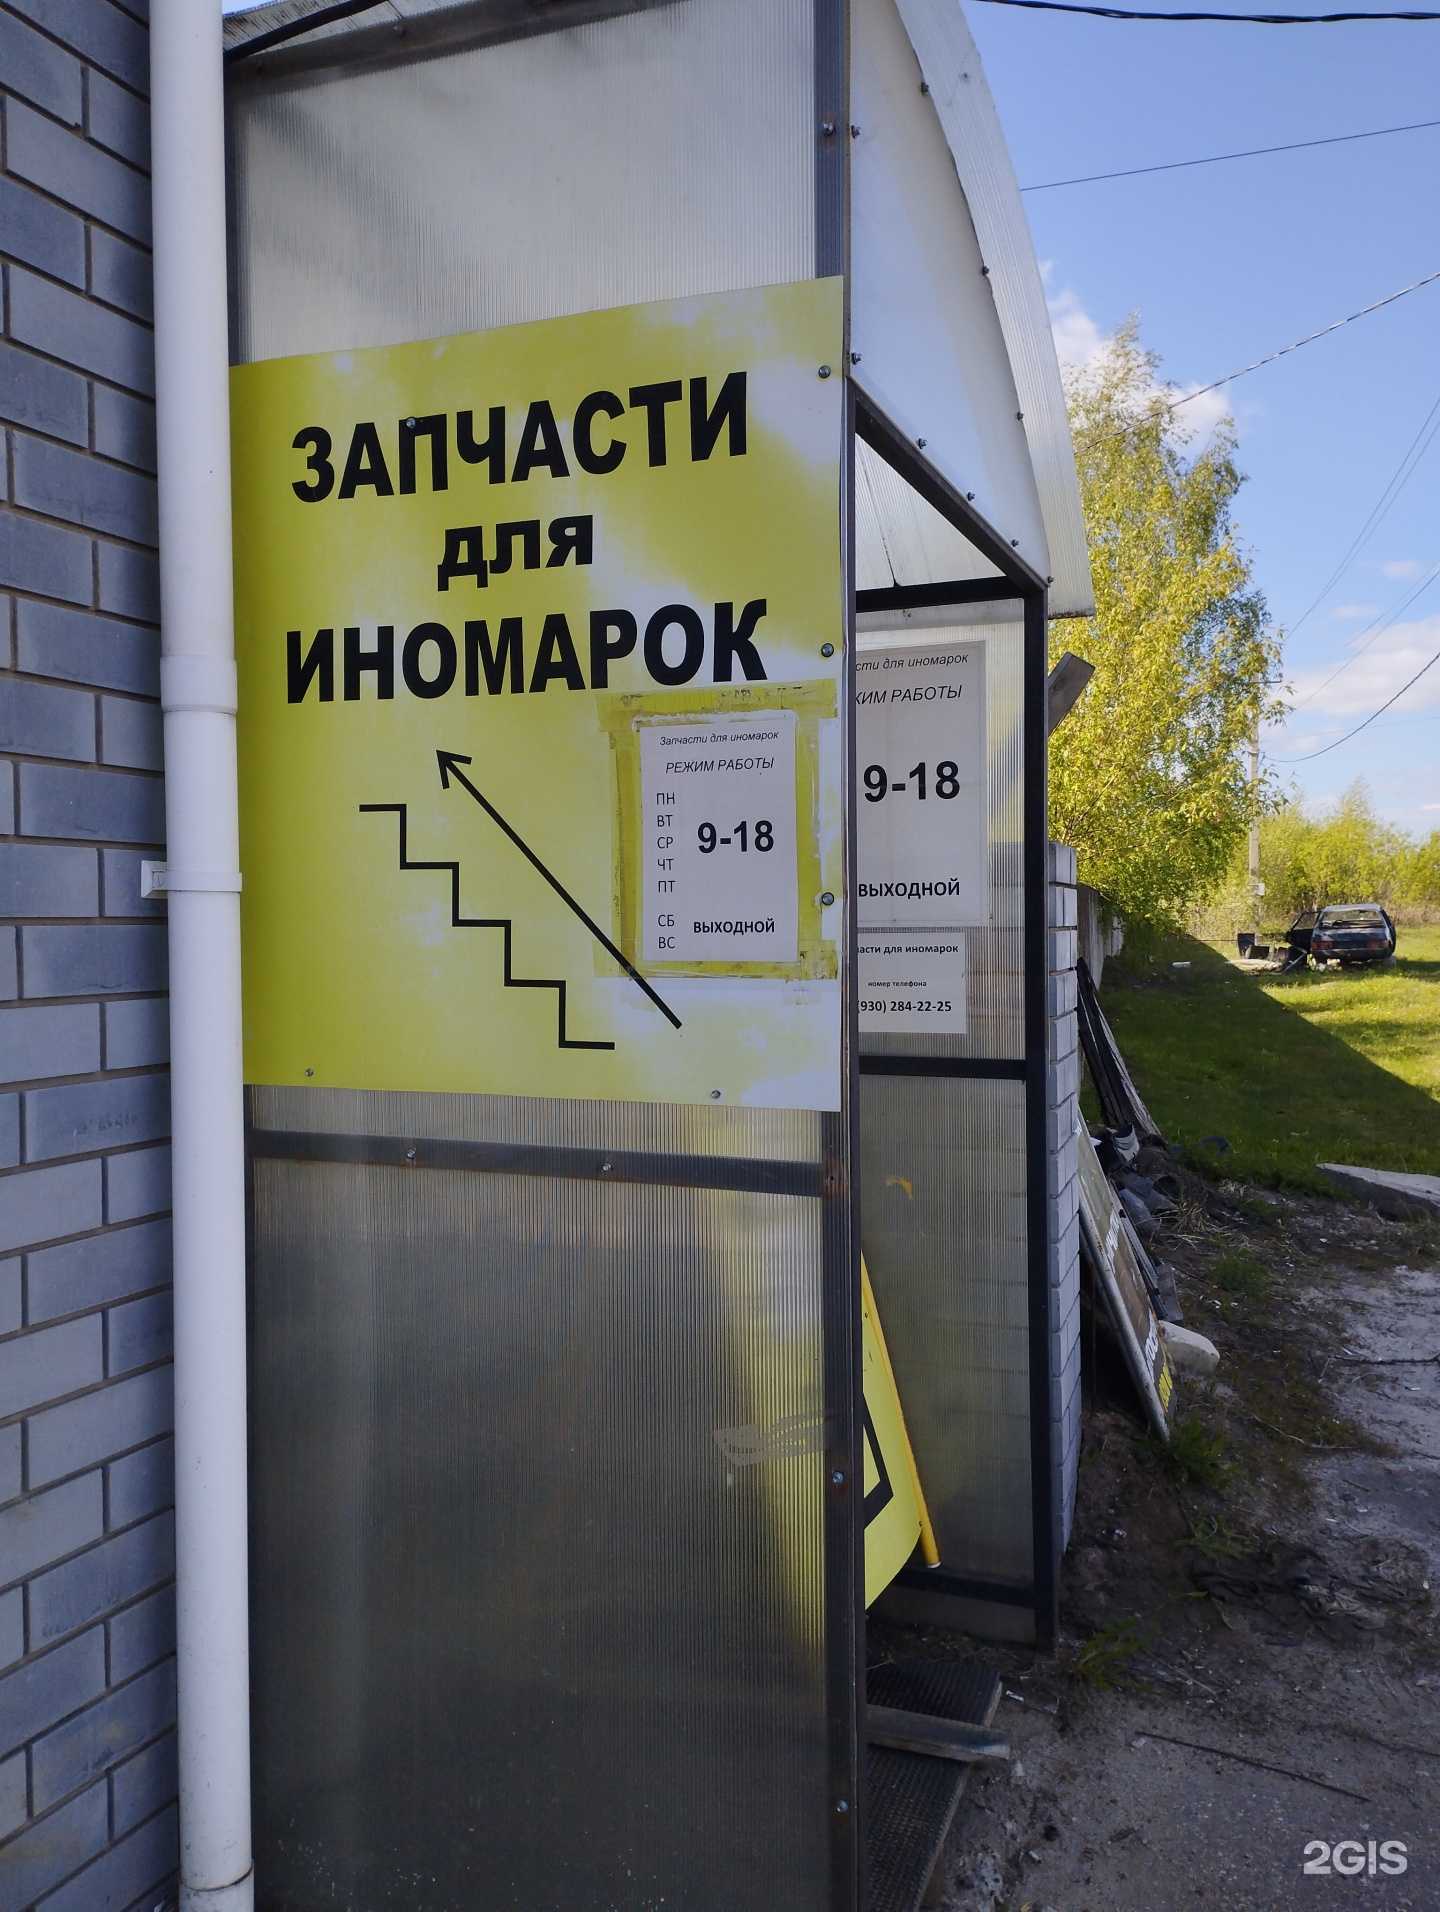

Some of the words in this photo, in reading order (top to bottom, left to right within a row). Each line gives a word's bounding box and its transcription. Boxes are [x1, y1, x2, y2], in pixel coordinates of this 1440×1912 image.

[292, 372, 746, 502] ЗАПЧАСТИ
[287, 599, 767, 703] ИНОМАРОК
[882, 657, 905, 670] для
[907, 654, 969, 668] иномарок
[890, 684, 963, 703] РАБОТЫ
[659, 735, 708, 746] Запчасти
[709, 732, 728, 743] для
[730, 731, 779, 742] иномарок
[665, 760, 715, 775] РЕЖИМ
[717, 757, 775, 772] РАБОТЫ
[863, 760, 961, 803] 9-18
[656, 791, 676, 806] ПН
[656, 814, 673, 828] ВТ
[656, 836, 674, 849] СР
[697, 819, 775, 854] 9-18
[657, 857, 675, 871] ЧТ
[657, 880, 677, 894] ПТ
[858, 877, 960, 900] ВЫХОДНОЙ
[657, 913, 675, 927] СБ
[693, 917, 775, 937] ВЫХОДНОЙ
[658, 936, 676, 950] ВС
[883, 946, 903, 956] для
[905, 945, 959, 955] иномарок
[890, 1000, 952, 1012] 284-22-25
